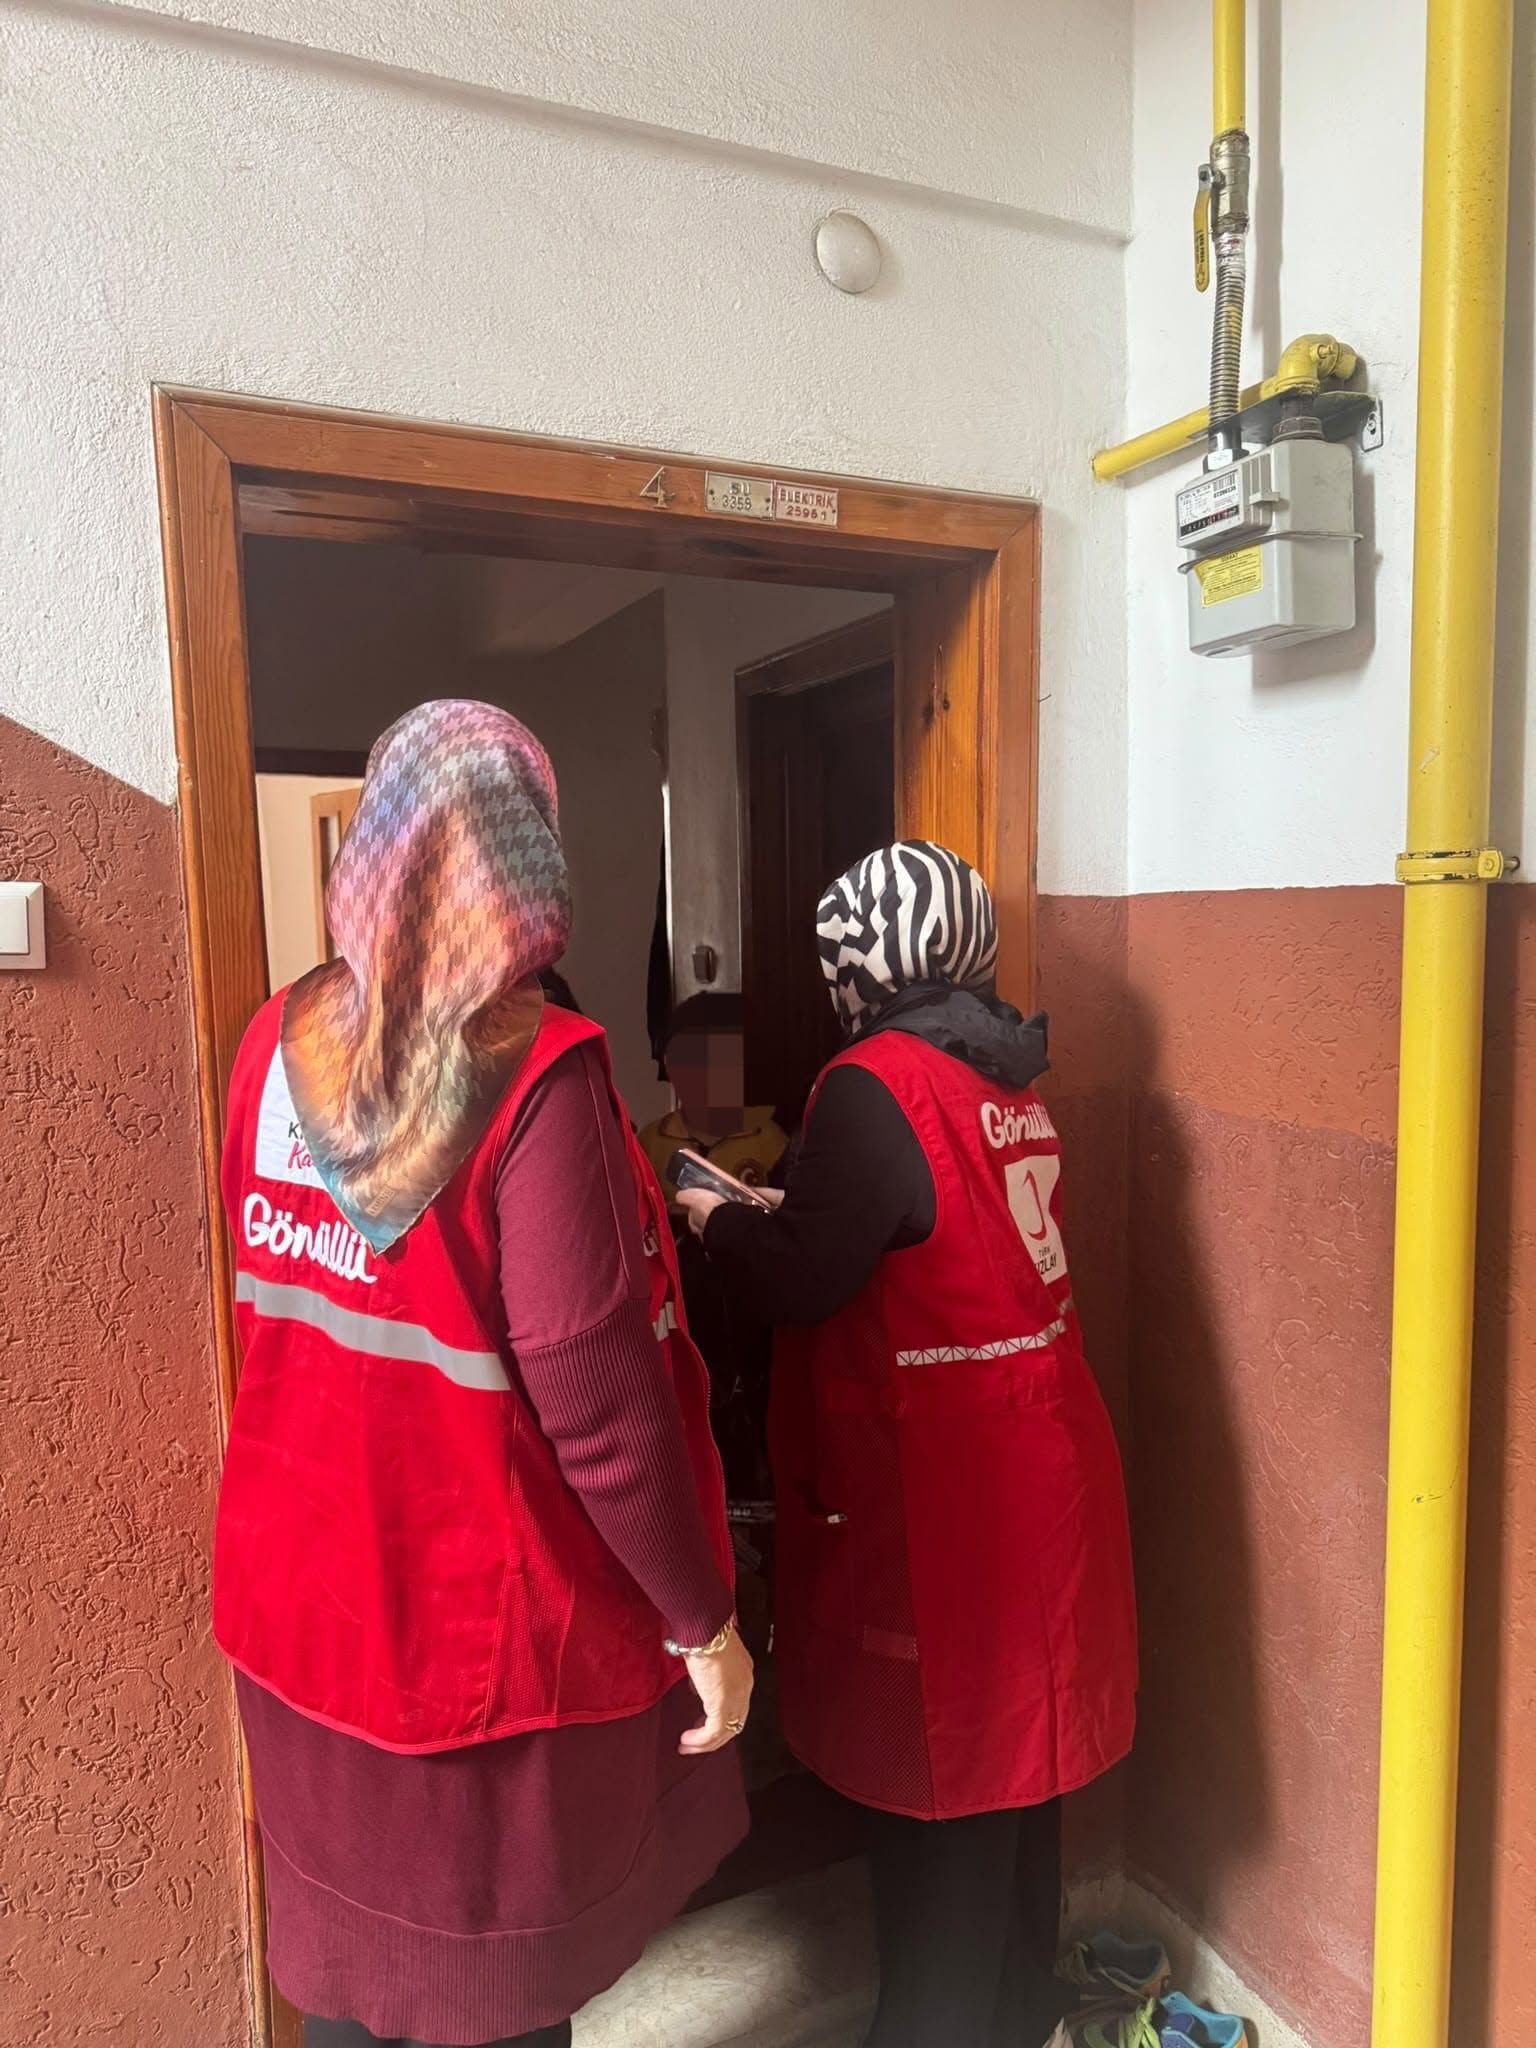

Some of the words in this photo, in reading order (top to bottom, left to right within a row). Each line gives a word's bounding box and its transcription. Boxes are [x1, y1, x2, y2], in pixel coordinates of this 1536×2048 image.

[639, 466, 675, 509] 4
[730, 482, 751, 496] SU
[243, 1192, 377, 1284] Gönüllü
